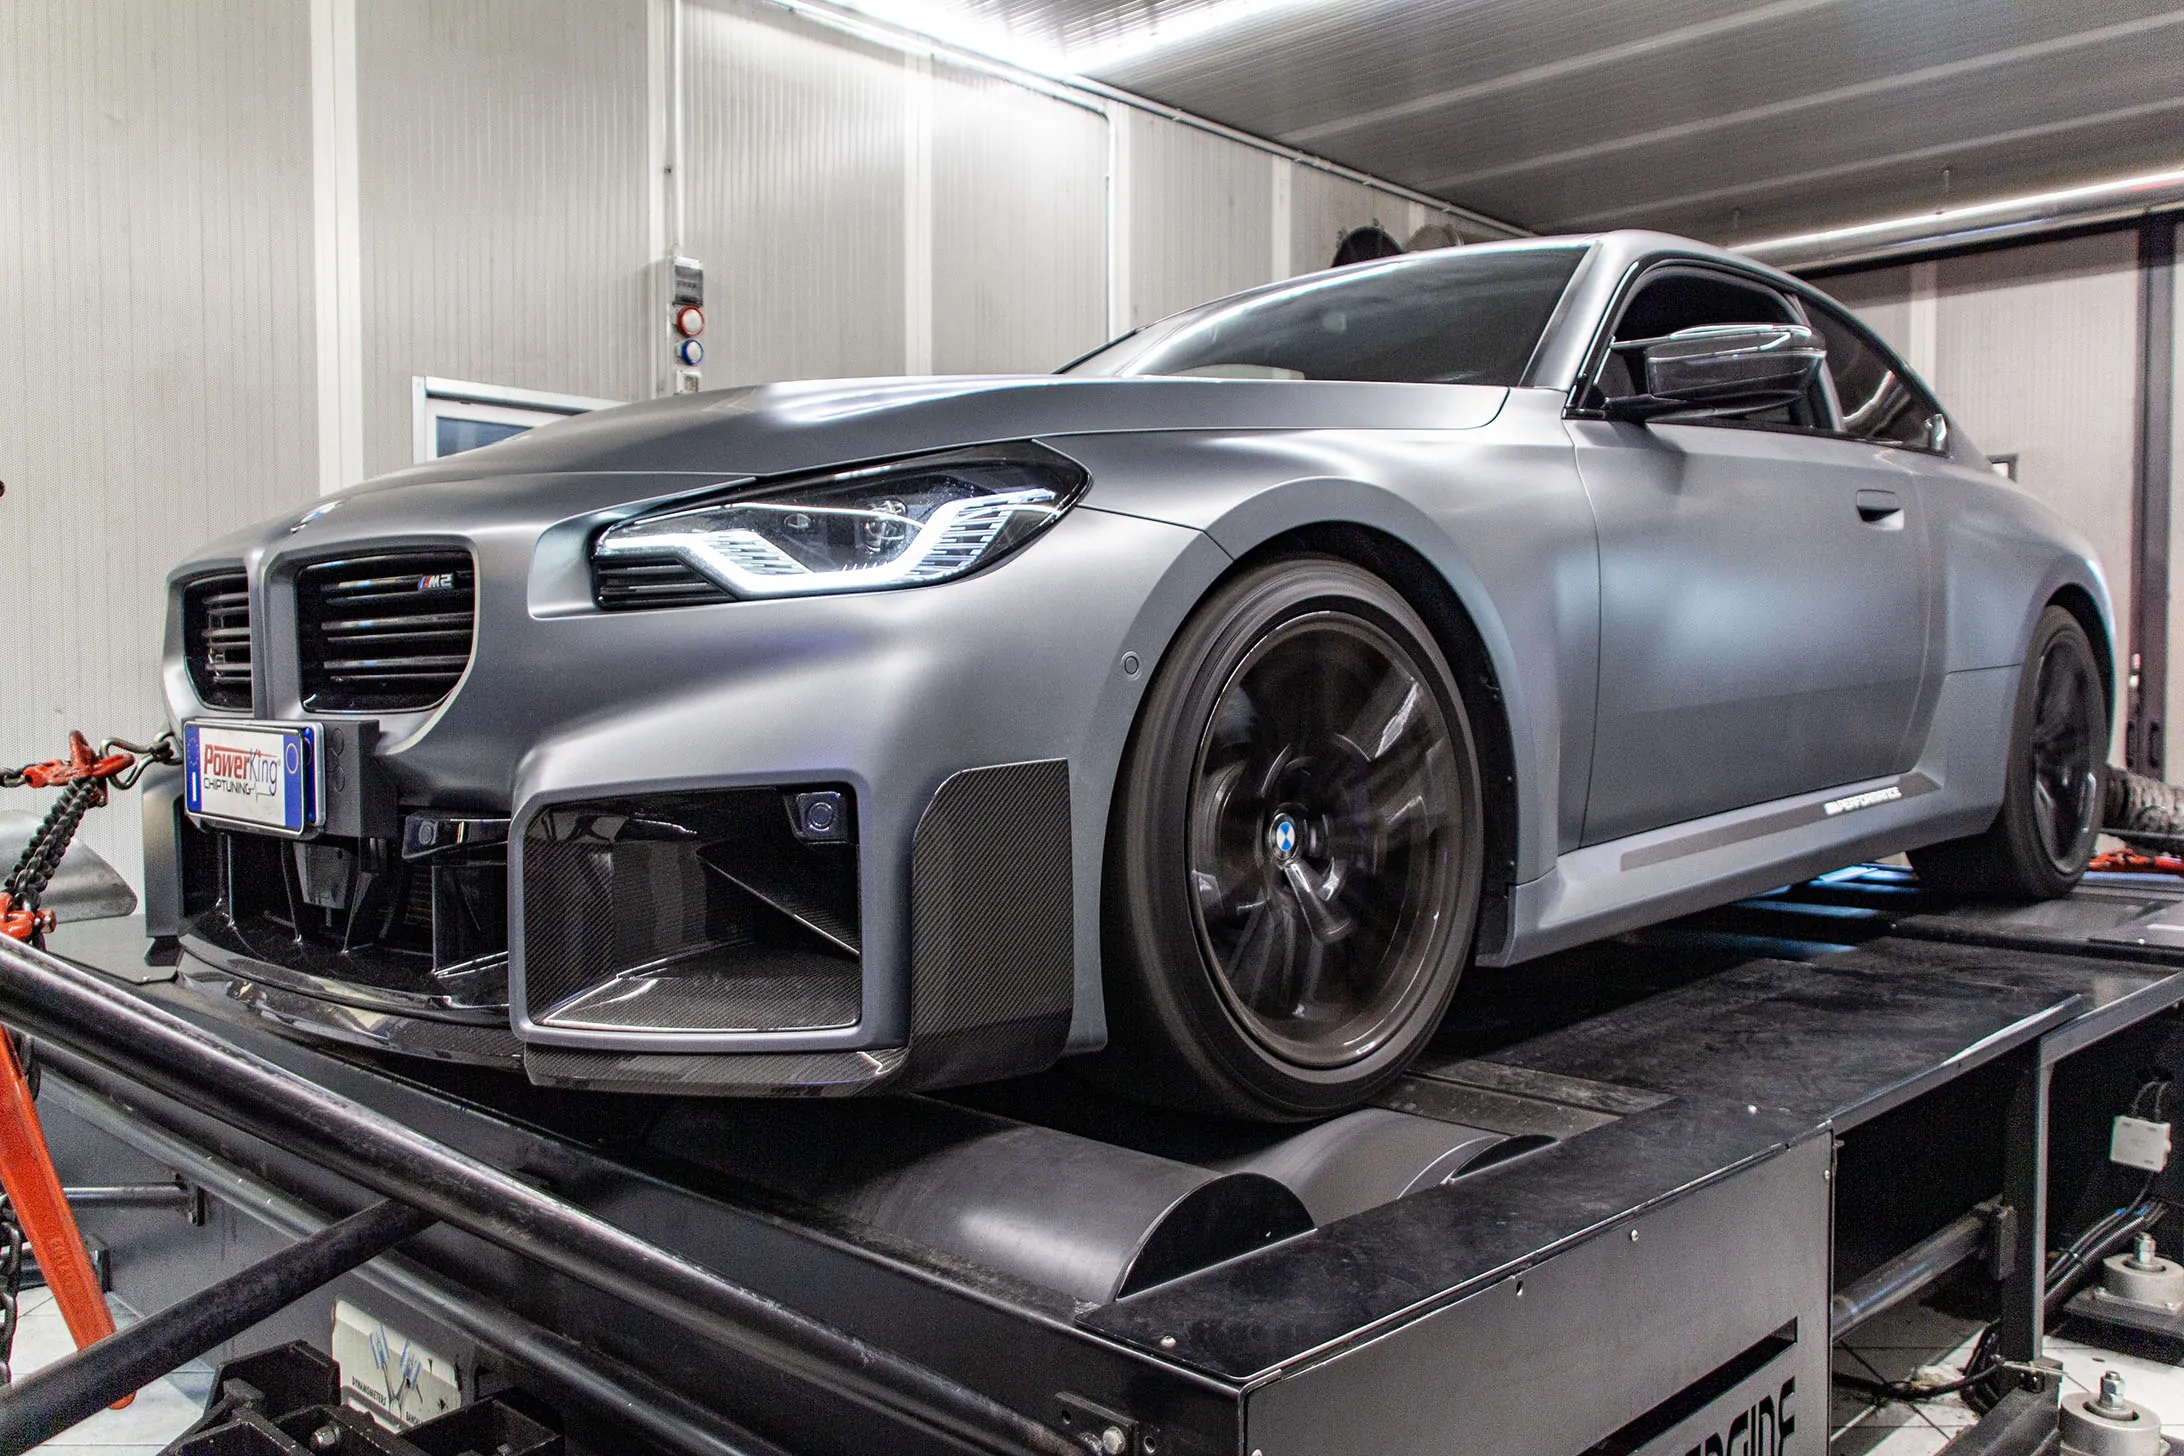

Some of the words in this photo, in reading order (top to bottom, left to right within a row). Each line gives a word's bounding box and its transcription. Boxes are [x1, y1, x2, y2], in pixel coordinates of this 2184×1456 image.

[427, 573, 454, 589] M2
[204, 744, 278, 797] PowerKing
[204, 777, 251, 795] CHIPTUNING
